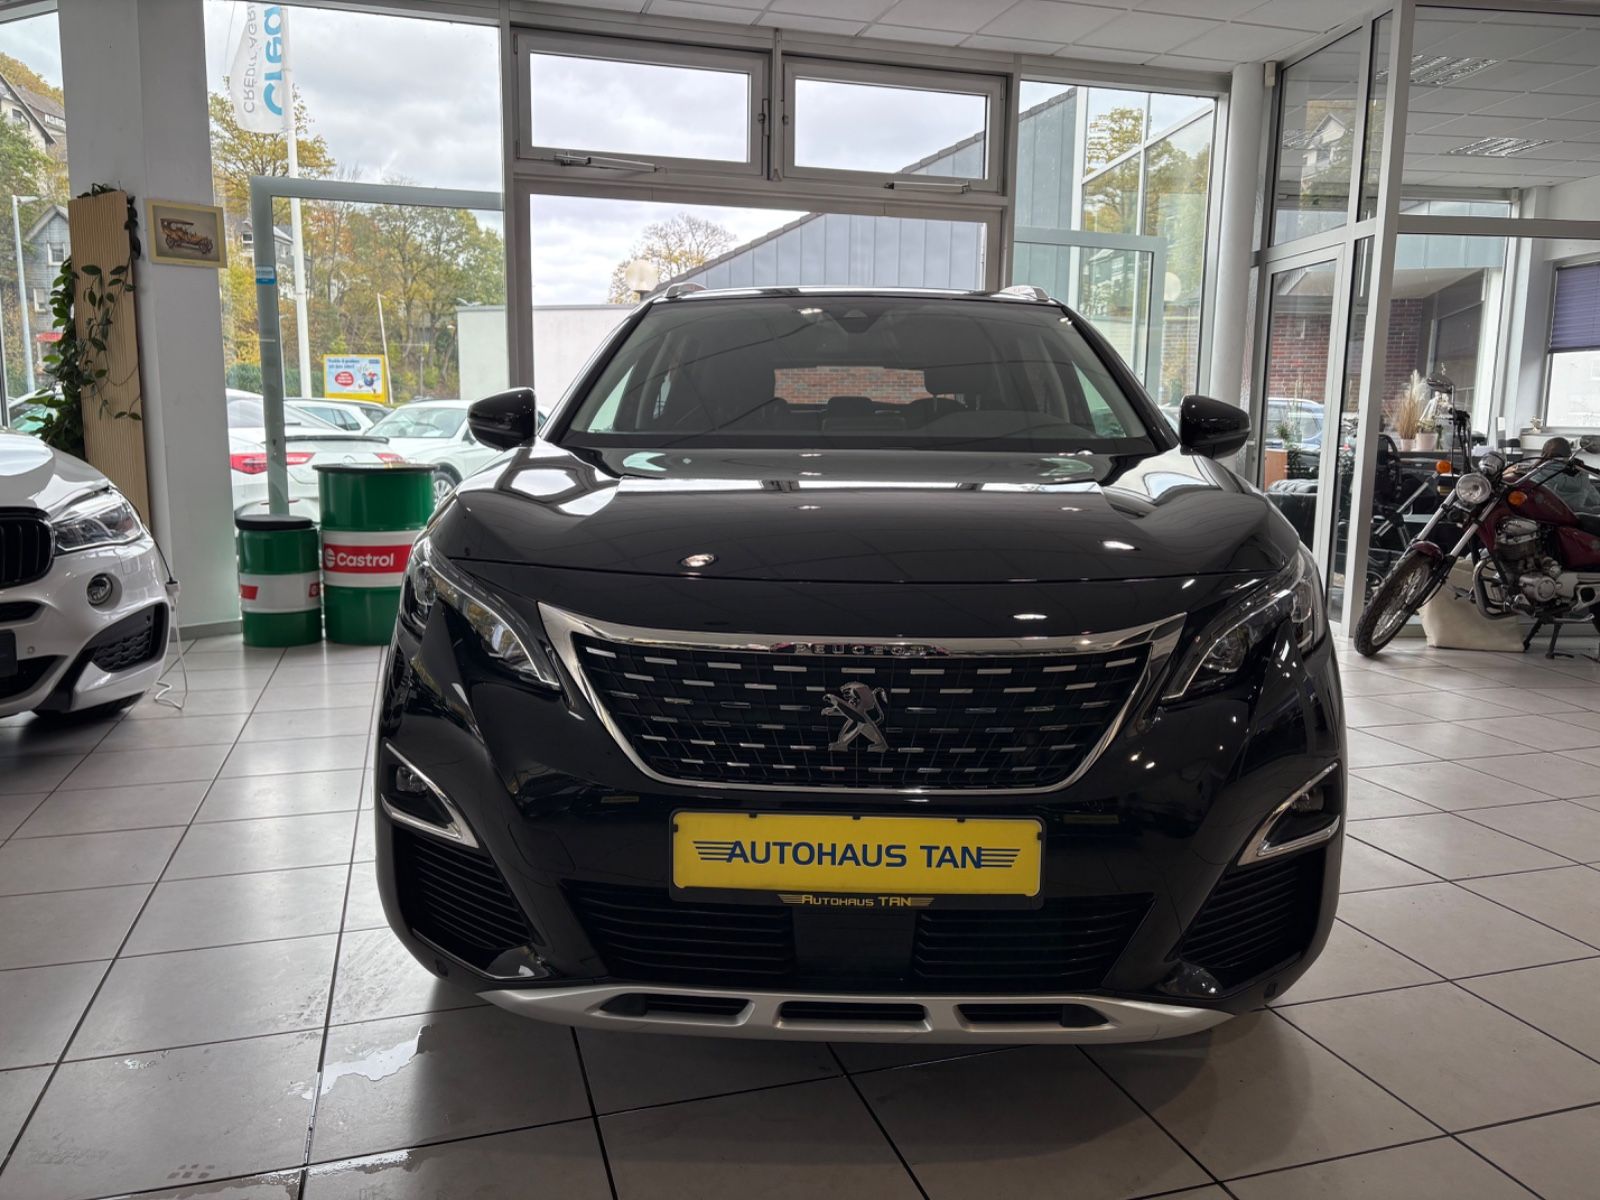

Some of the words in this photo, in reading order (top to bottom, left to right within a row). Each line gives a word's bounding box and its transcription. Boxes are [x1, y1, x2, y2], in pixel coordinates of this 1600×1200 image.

[336, 552, 394, 567] Castrol
[726, 840, 907, 868] AUTOHAUS
[919, 846, 982, 869] TAN
[878, 897, 911, 907] TAN
